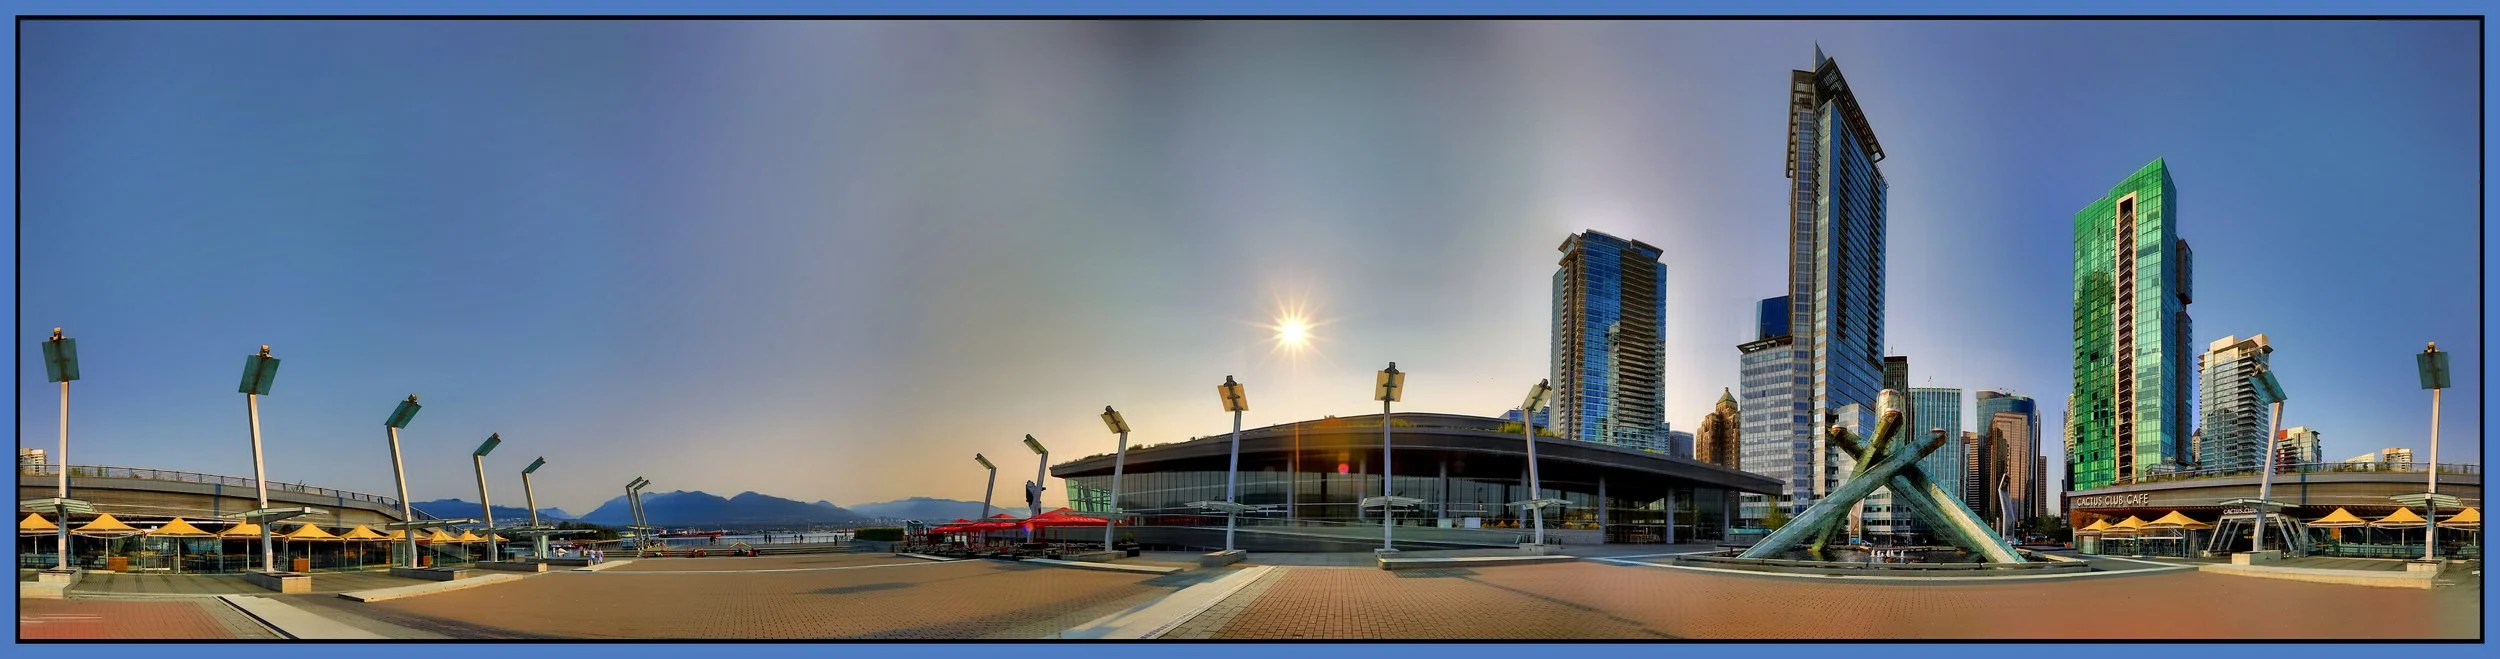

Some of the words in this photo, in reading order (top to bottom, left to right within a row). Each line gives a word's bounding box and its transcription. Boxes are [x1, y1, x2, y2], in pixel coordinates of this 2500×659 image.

[2076, 496, 2103, 506] CACTUS
[2104, 495, 2124, 505] CLUB
[2126, 493, 2149, 505] CAFE
